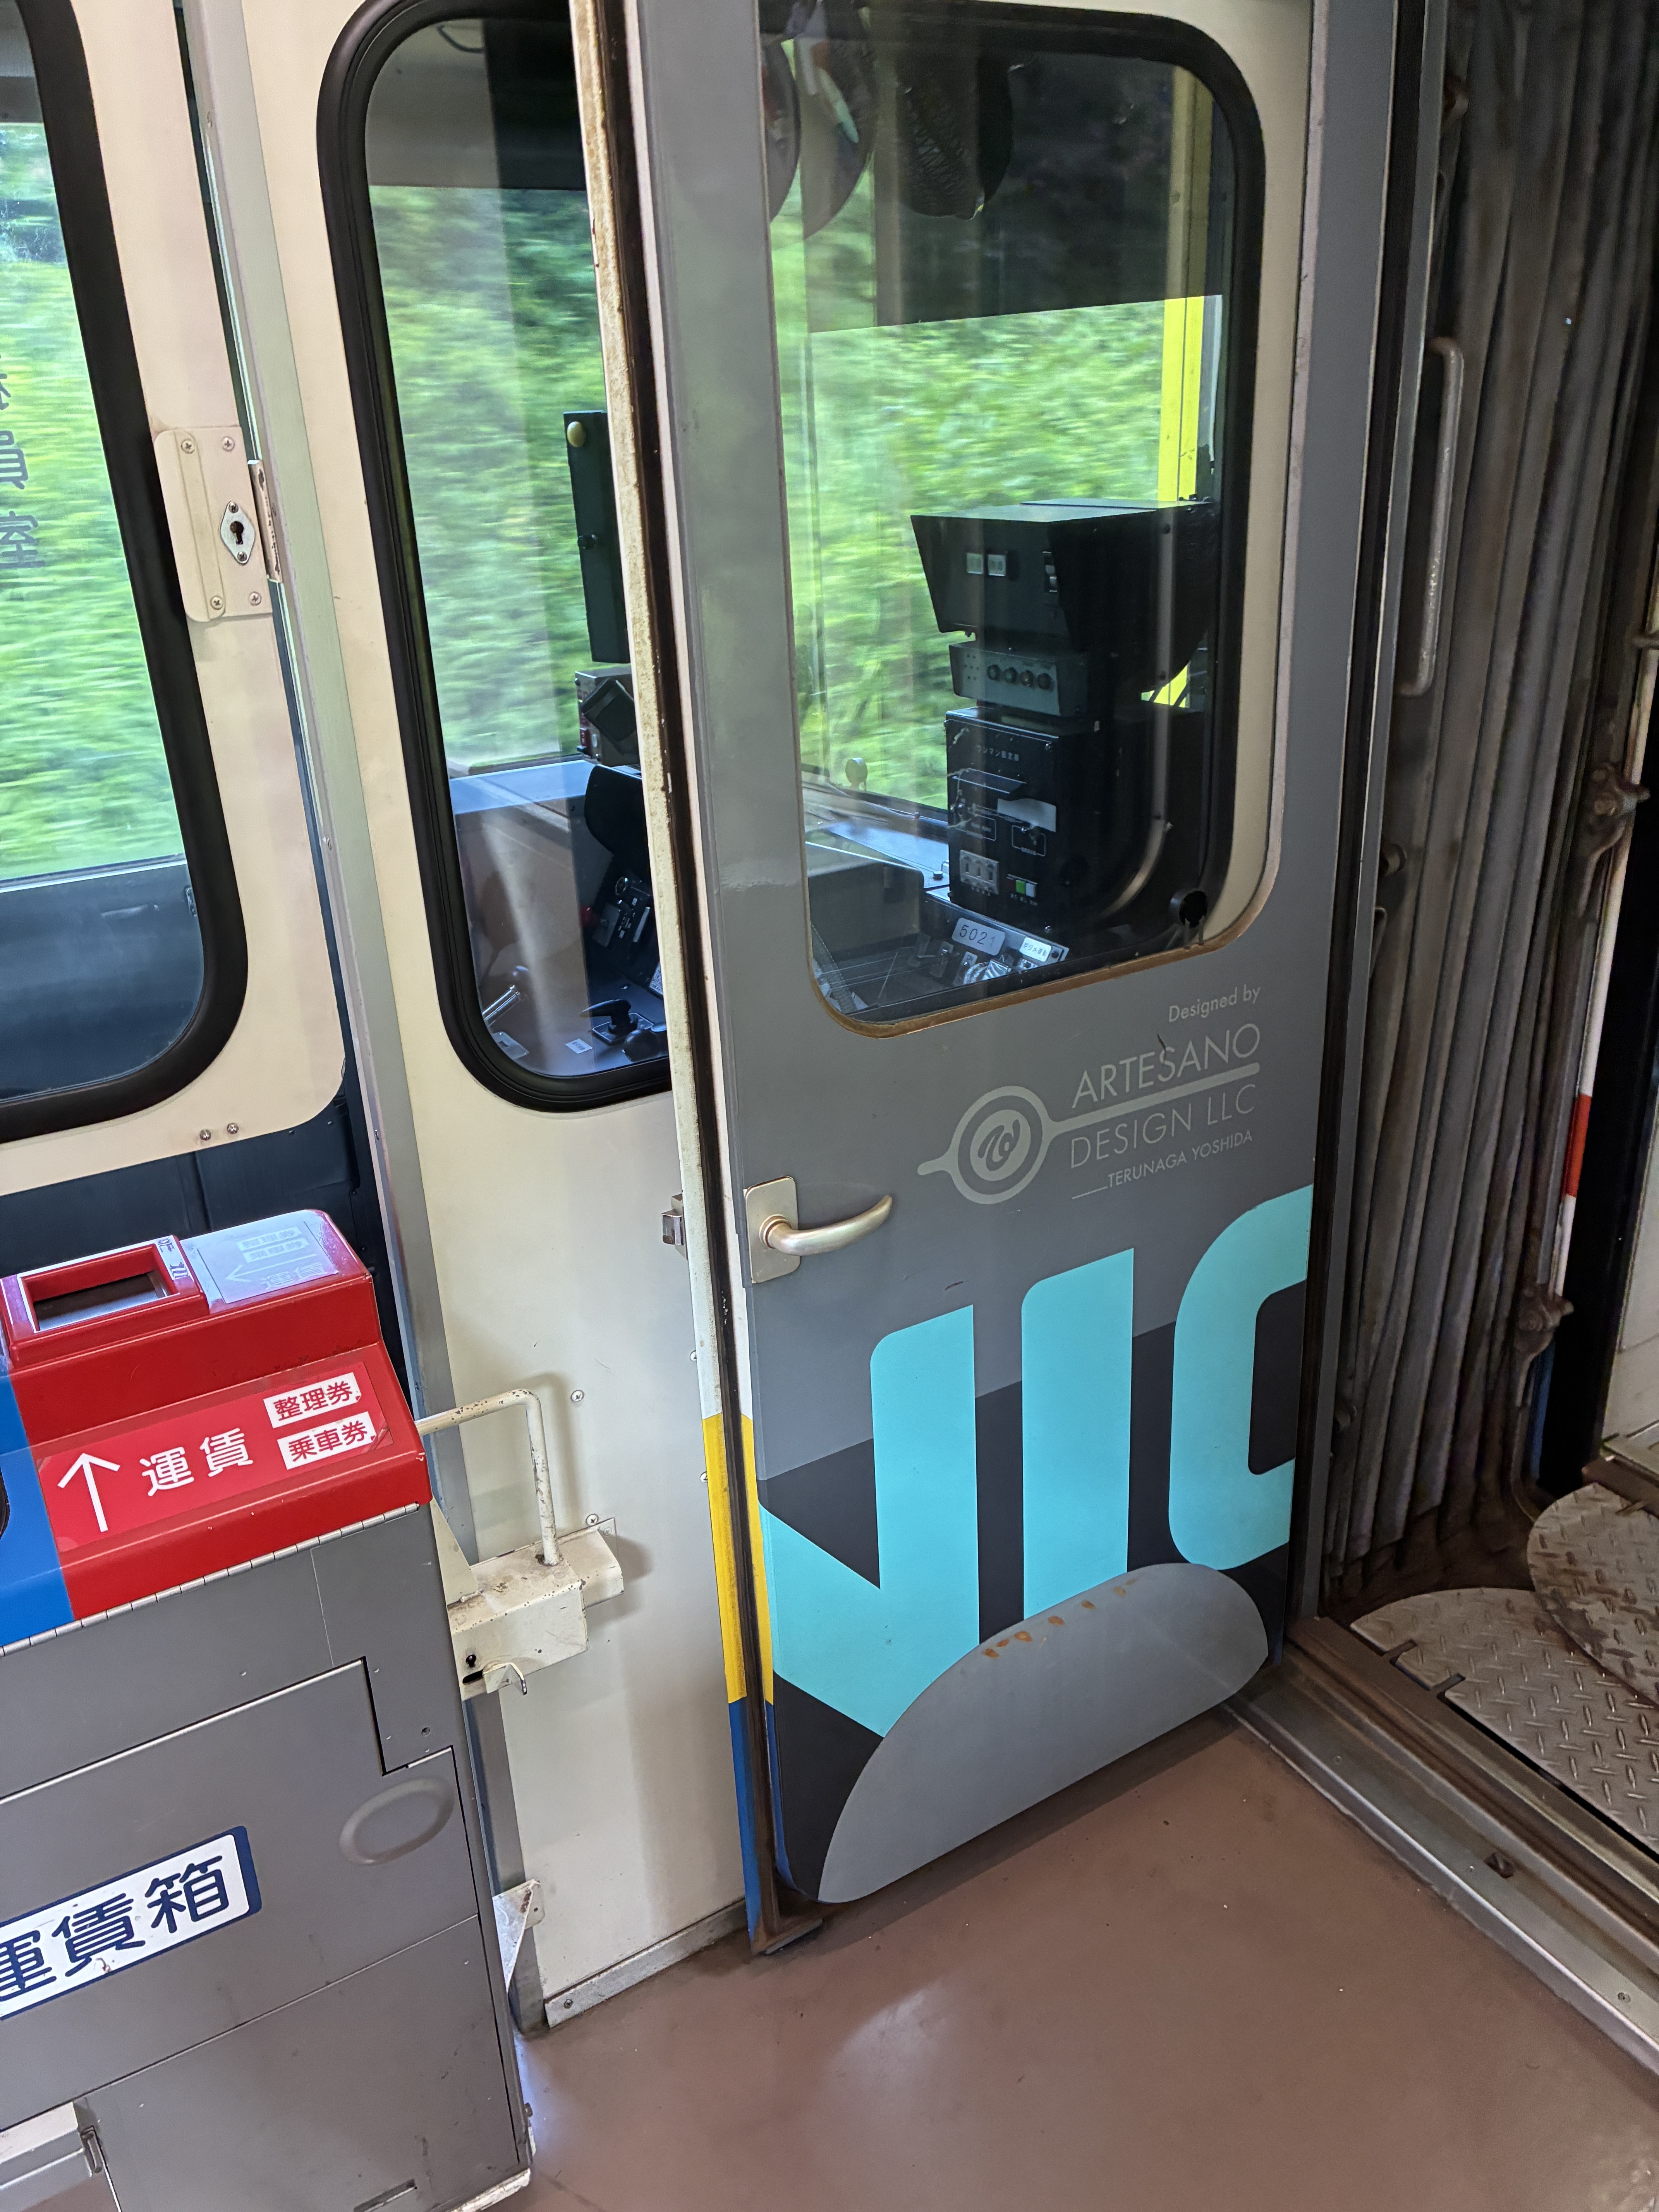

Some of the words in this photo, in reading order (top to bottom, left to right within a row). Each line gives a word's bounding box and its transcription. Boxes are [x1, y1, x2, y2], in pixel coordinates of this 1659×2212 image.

[1169, 987, 1238, 1022] Designed
[1243, 985, 1261, 1004] by
[1072, 1023, 1261, 1108] ARTESANO
[1071, 1103, 1192, 1169] DESIGN
[1207, 1084, 1255, 1125] LLC
[1108, 1151, 1187, 1188] TERUNAGA
[1192, 1130, 1252, 1161] YOSHIDA
[273, 1381, 354, 1421] 整理券
[139, 1428, 253, 1497] 運賃
[289, 1420, 368, 1462] 乗車券
